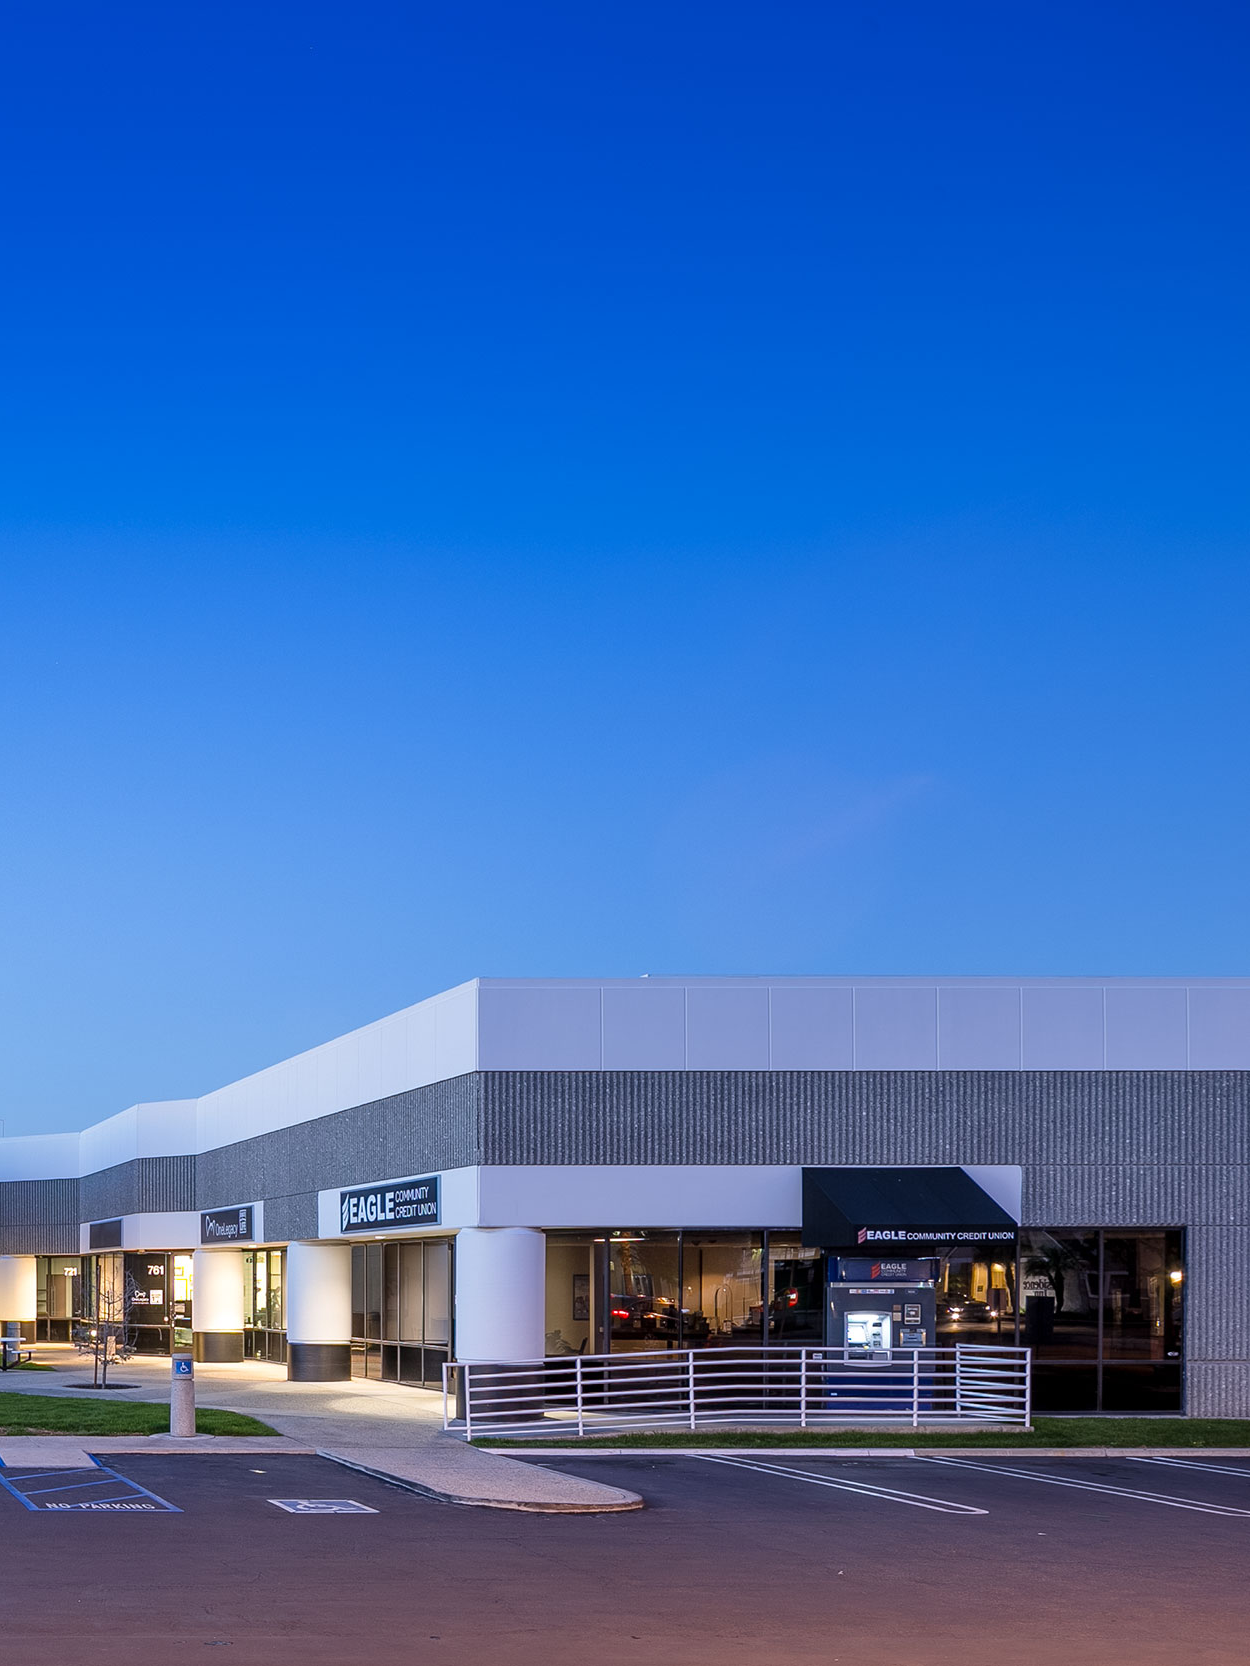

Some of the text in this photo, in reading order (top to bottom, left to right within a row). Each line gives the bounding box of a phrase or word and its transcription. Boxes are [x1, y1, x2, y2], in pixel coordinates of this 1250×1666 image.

[395, 1186, 429, 1203] COMMUNITY
[349, 1192, 395, 1224] EAGLE
[395, 1202, 437, 1219] CREDIT UNION
[866, 1230, 1015, 1240] EAGLE COMMUNITY CREDIT UNION
[63, 1267, 78, 1277] 721
[147, 1265, 165, 1276] 761
[78, 1502, 156, 1510] PARKING
